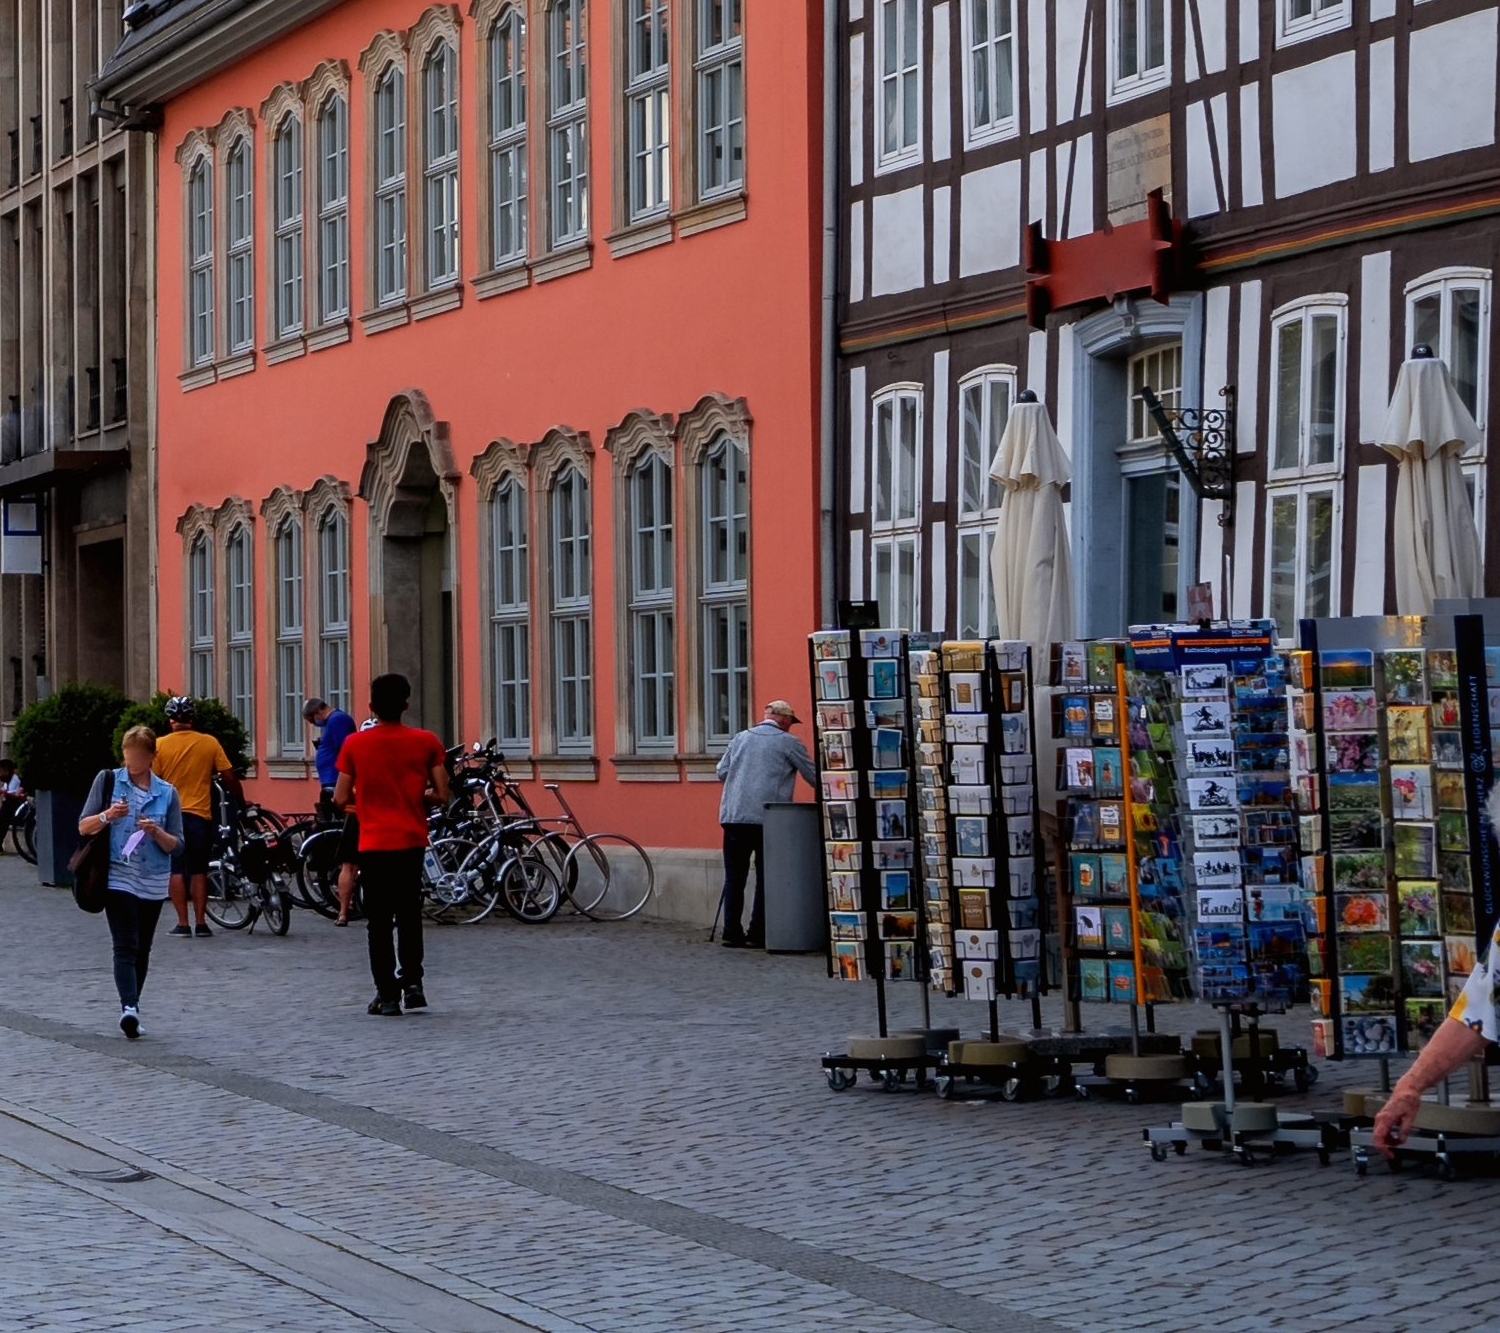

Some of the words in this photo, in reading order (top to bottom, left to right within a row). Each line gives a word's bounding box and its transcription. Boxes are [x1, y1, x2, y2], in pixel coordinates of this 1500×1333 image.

[1468, 674, 1482, 749] LEIDENSCHAFT
[1475, 776, 1485, 803] HERZ
[1479, 828, 1494, 915] GLÜCKWÜNSCHE
